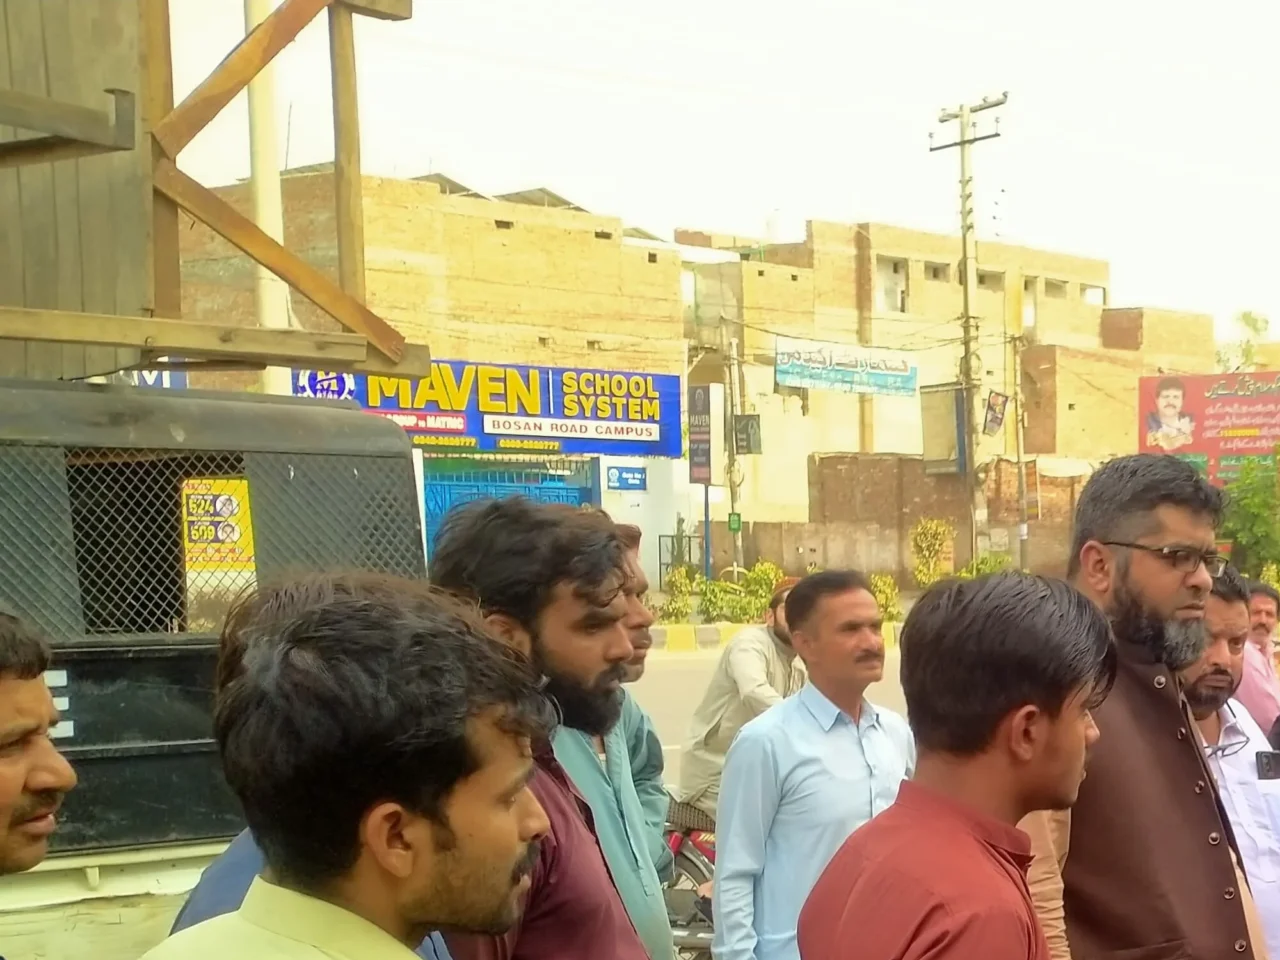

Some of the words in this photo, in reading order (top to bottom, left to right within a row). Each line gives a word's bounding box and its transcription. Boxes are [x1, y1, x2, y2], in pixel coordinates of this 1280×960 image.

[367, 362, 541, 415] MAVEN
[562, 372, 659, 398] SCHOOL
[563, 394, 660, 421] SYSTEM
[689, 414, 710, 427] MAVEN
[492, 419, 543, 432] BOSAN
[550, 423, 589, 435] ROAD
[595, 425, 654, 437] CAMPUS
